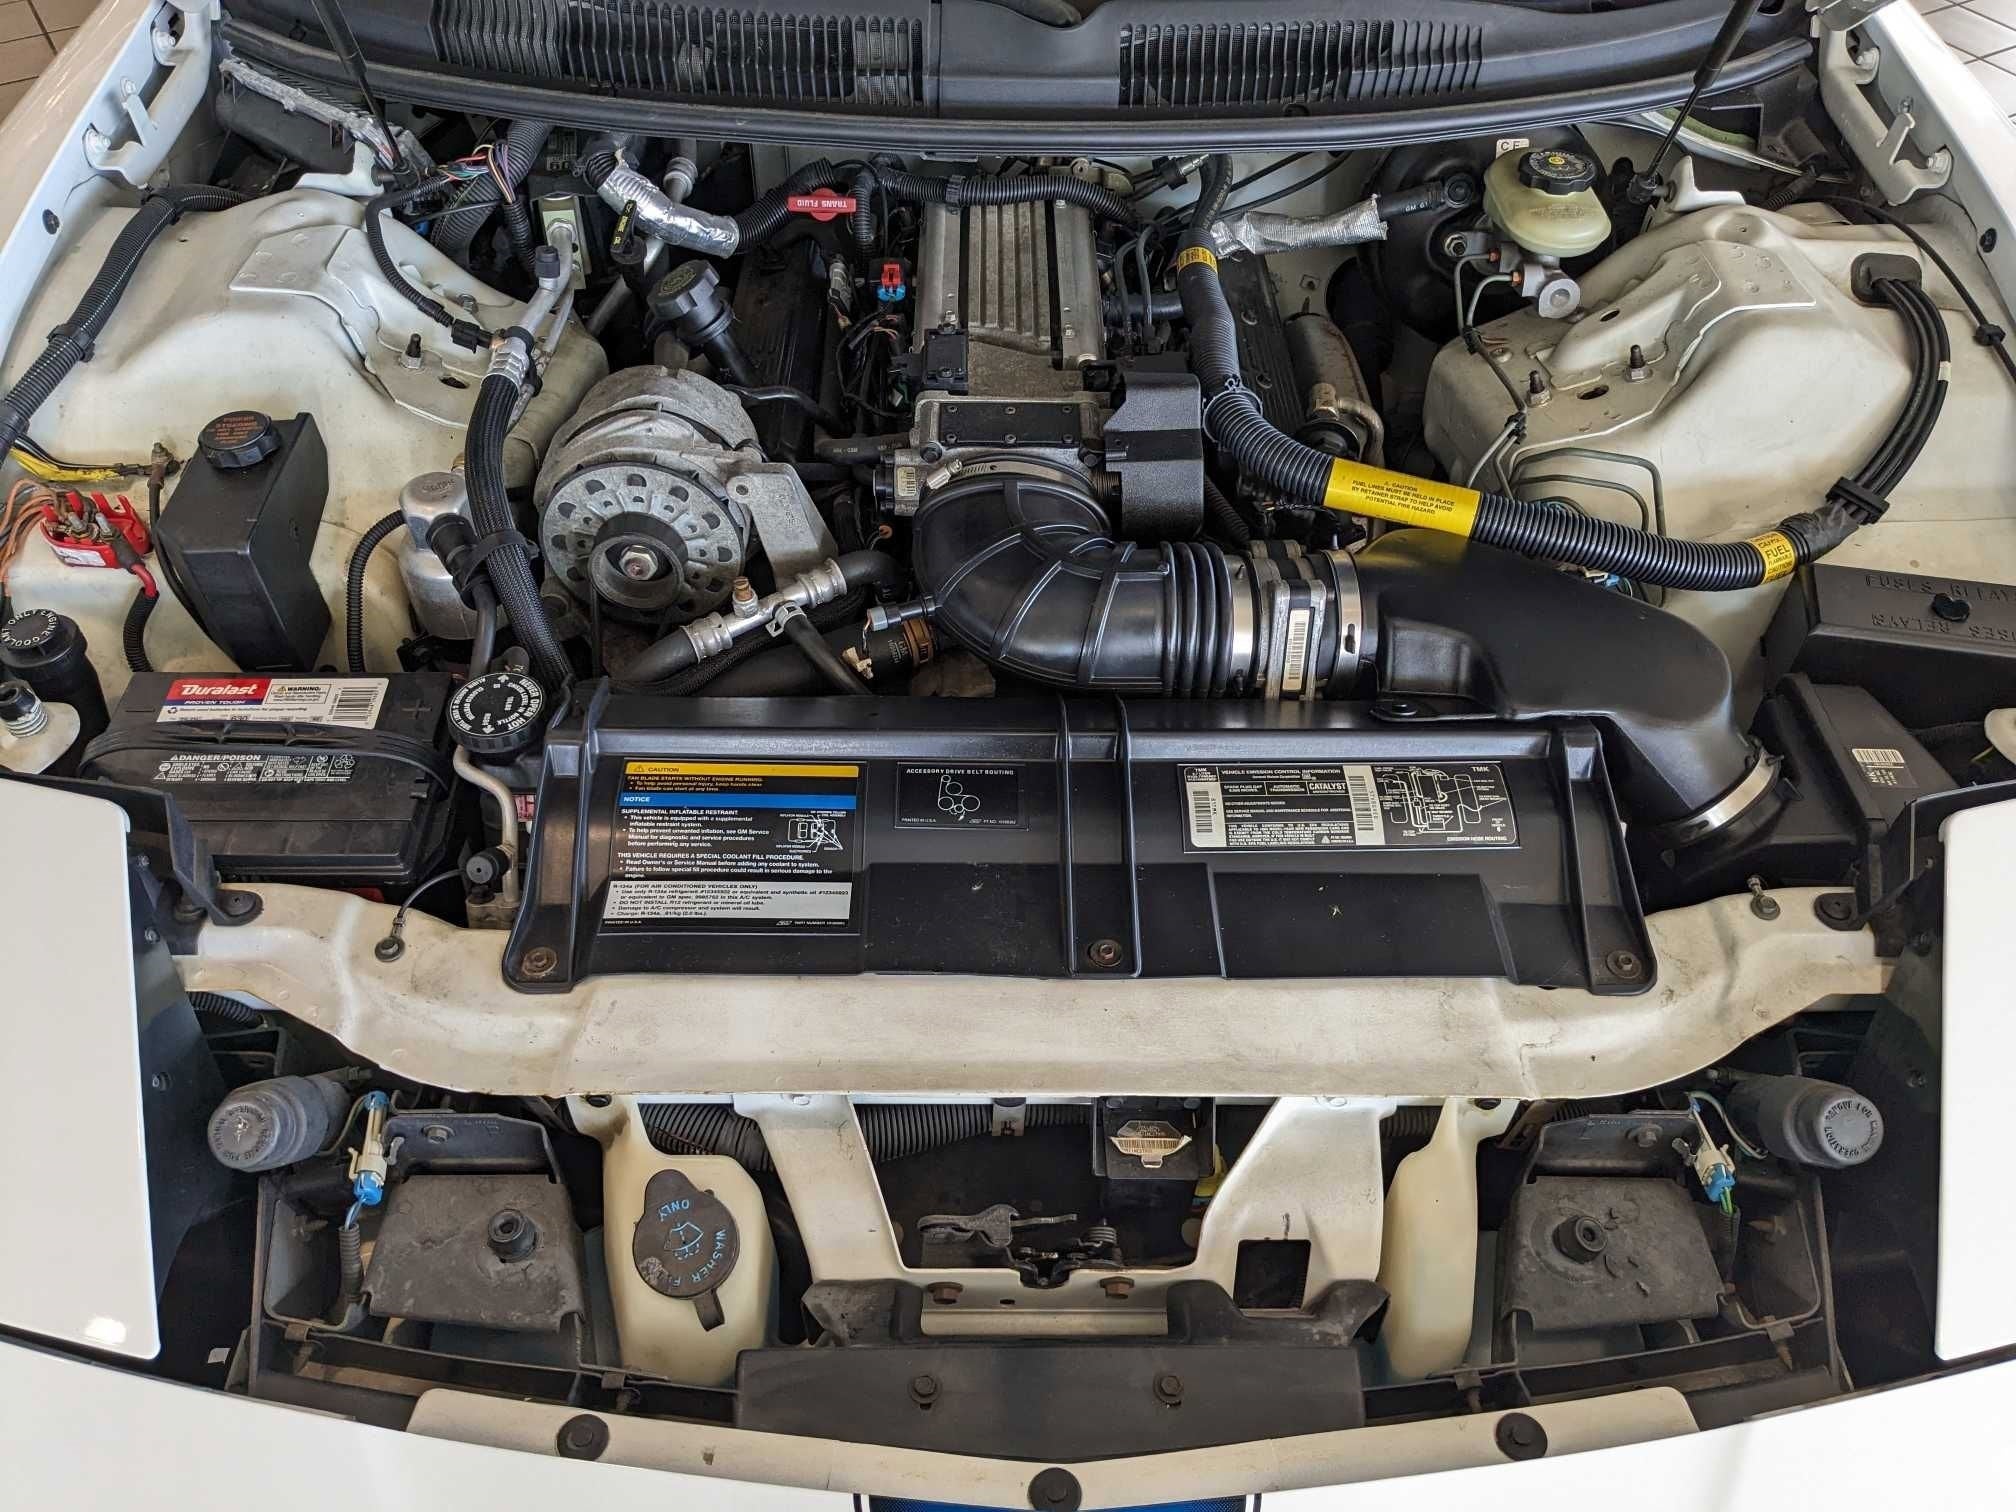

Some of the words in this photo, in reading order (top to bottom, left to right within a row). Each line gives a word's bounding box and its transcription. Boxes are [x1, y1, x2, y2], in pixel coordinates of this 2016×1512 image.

[797, 199, 818, 208] FLUID
[822, 200, 847, 208] TRANS
[1368, 483, 1384, 491] LINES
[1386, 486, 1402, 494] MUST
[1412, 492, 1428, 500] HELD
[1436, 498, 1455, 506] PLACE
[1392, 482, 1418, 492] CAUTION
[1360, 488, 1388, 498] RETAINER
[1390, 494, 1408, 502] STRAP
[1419, 500, 1434, 508] HELP
[1435, 503, 1453, 512] AVOID
[1366, 496, 1396, 507] POTENTIAL
[1412, 504, 1436, 514] HAZARD
[1765, 544, 1790, 558] FUEL
[8, 610, 36, 624] ONLY
[41, 610, 57, 636] ENGINE
[2, 628, 40, 646] COOLANT
[182, 684, 258, 696] Duralast
[520, 678, 540, 698] NEVER
[524, 698, 540, 718] OPEN
[508, 718, 526, 730] HOT
[658, 1200, 690, 1222] ONLY
[692, 1229, 726, 1282] WASHER
